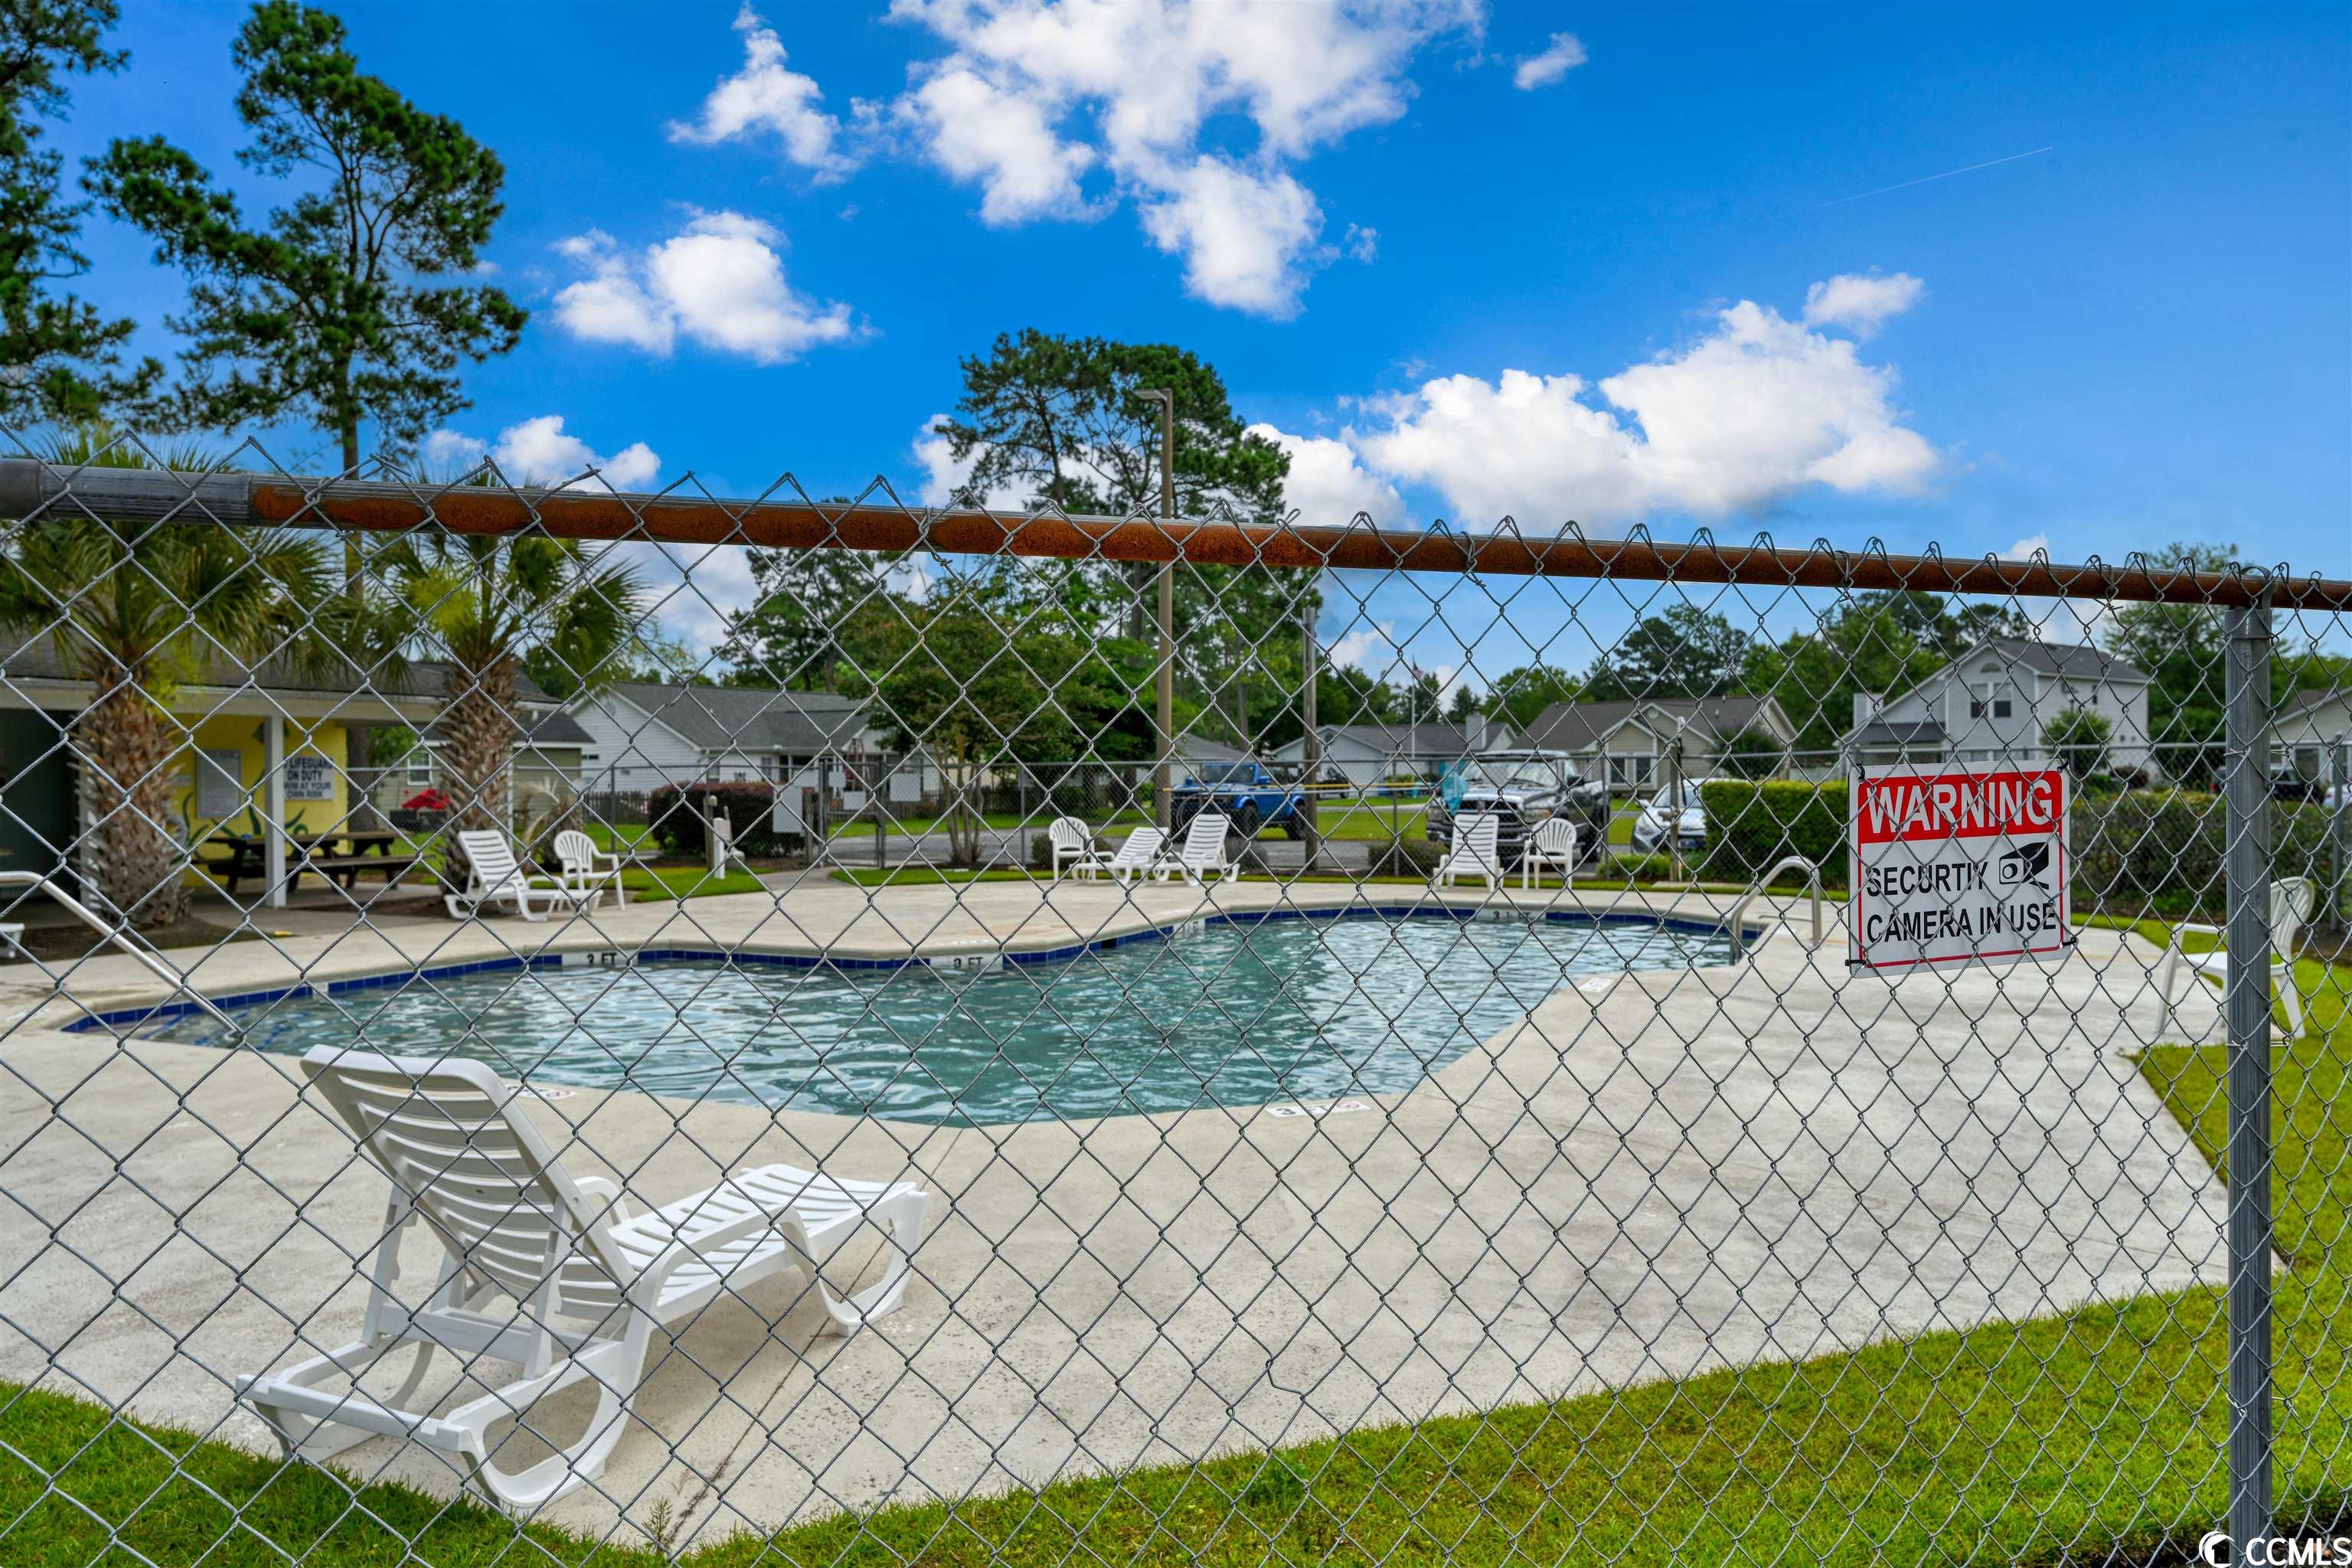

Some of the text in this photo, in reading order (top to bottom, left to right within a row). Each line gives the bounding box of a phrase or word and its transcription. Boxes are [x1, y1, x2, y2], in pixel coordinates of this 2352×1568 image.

[287, 769, 322, 780] ON DUTY
[1867, 779, 2053, 834] WARNING
[1867, 861, 1988, 896] SECURTIY
[1867, 903, 2057, 942] CAMERA IN USE
[601, 952, 617, 965] FT
